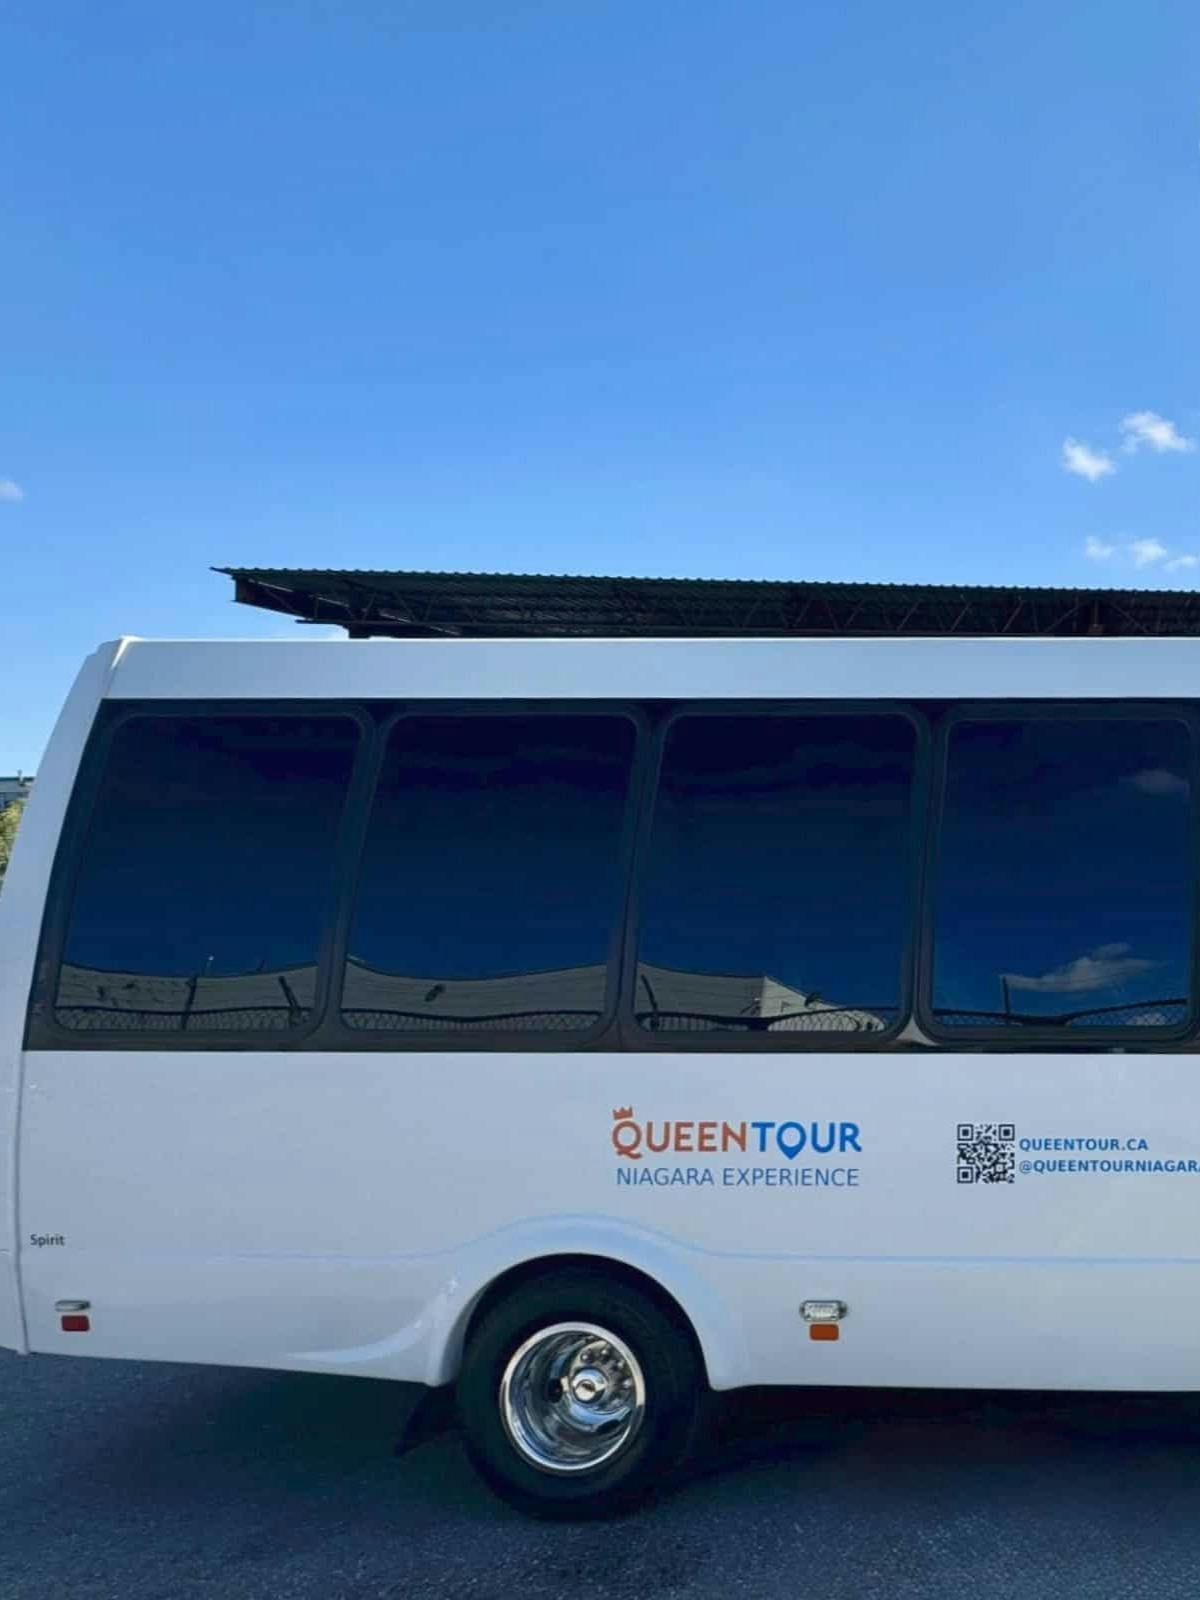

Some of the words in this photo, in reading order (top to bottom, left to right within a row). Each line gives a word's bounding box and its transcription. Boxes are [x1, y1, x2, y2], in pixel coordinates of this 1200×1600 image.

[612, 1120, 863, 1160] QUEENTOUR
[1018, 1138, 1149, 1151] QUEENTOUR.CA
[616, 1167, 715, 1186] NIAGARA
[723, 1167, 860, 1187] EXPERIENCE
[30, 1233, 65, 1248] Spirit
